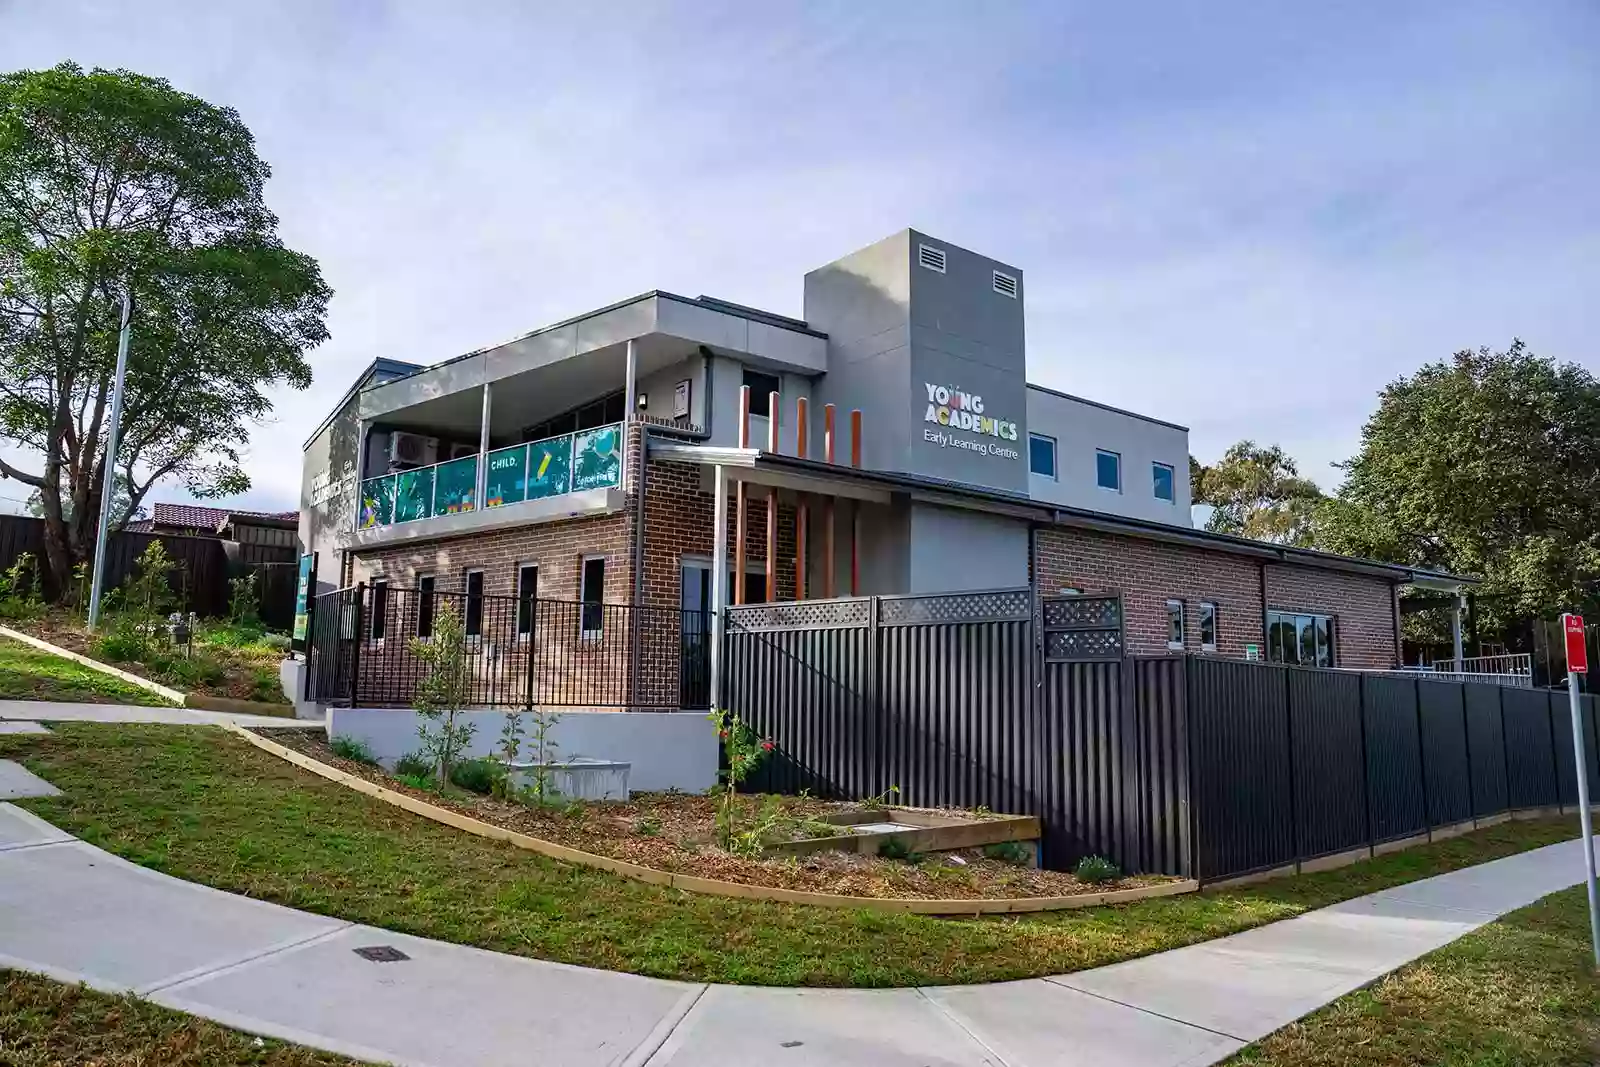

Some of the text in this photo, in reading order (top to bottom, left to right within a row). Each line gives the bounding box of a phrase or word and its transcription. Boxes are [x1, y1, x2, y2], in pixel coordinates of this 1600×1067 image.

[924, 382, 984, 414] YOUNG
[924, 403, 1018, 441] ACADEMICS
[923, 428, 1019, 460] Early Learning Centre
